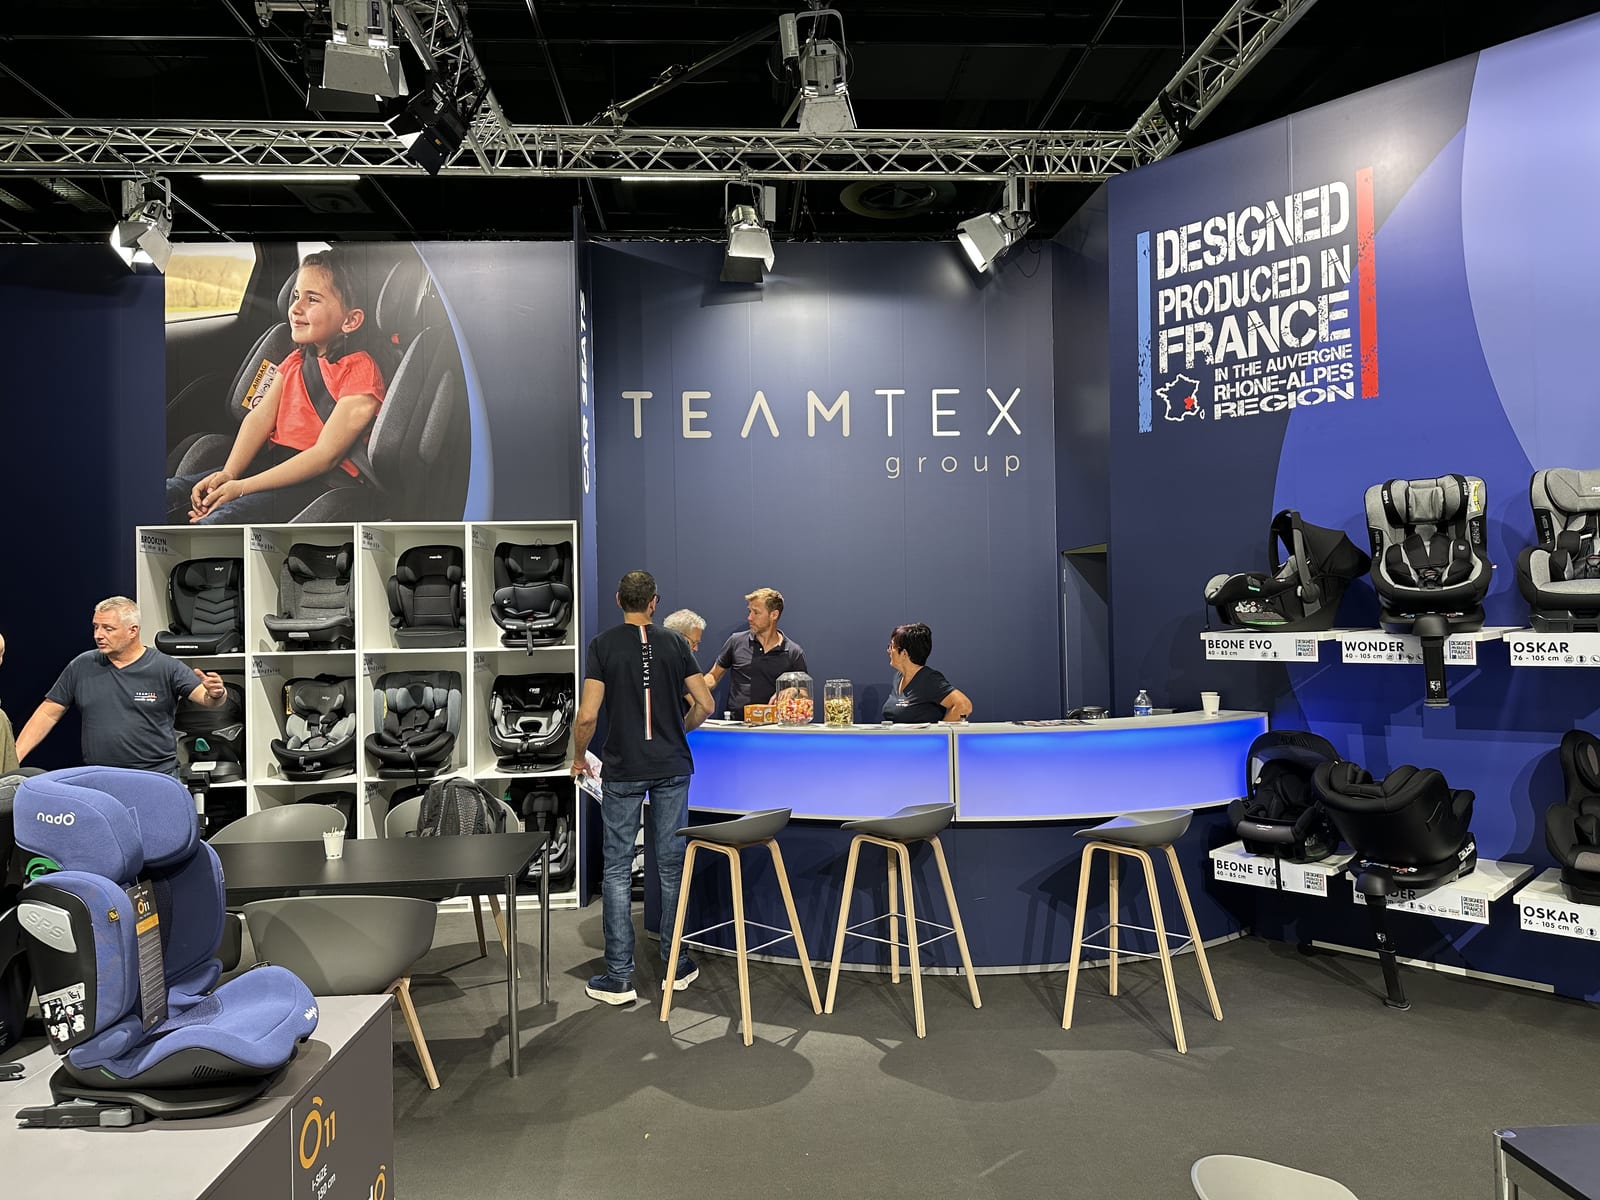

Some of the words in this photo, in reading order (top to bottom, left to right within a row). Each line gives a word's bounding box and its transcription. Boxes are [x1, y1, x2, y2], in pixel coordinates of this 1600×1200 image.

[1156, 181, 1350, 280] DESIGNED
[1158, 255, 1311, 325] PRODUCED
[1320, 244, 1351, 289] IN
[1159, 290, 1351, 374] FRANCE
[1214, 366, 1229, 382] IN
[1232, 360, 1262, 377] THE
[1266, 343, 1353, 373] AUVERGNE
[1213, 362, 1354, 403] RHONE-ALPES
[1213, 382, 1355, 421] REGION
[621, 388, 1022, 439] TEAMTEX
[885, 454, 1021, 479] group
[1207, 639, 1245, 650] BEONE
[1249, 640, 1272, 650] EVO
[1344, 641, 1404, 652] WONDER
[1513, 642, 1569, 653] OSKAR
[642, 645, 650, 686] TEAMTEX
[1216, 860, 1252, 874] BEONE
[1523, 906, 1579, 924] OSKAR
